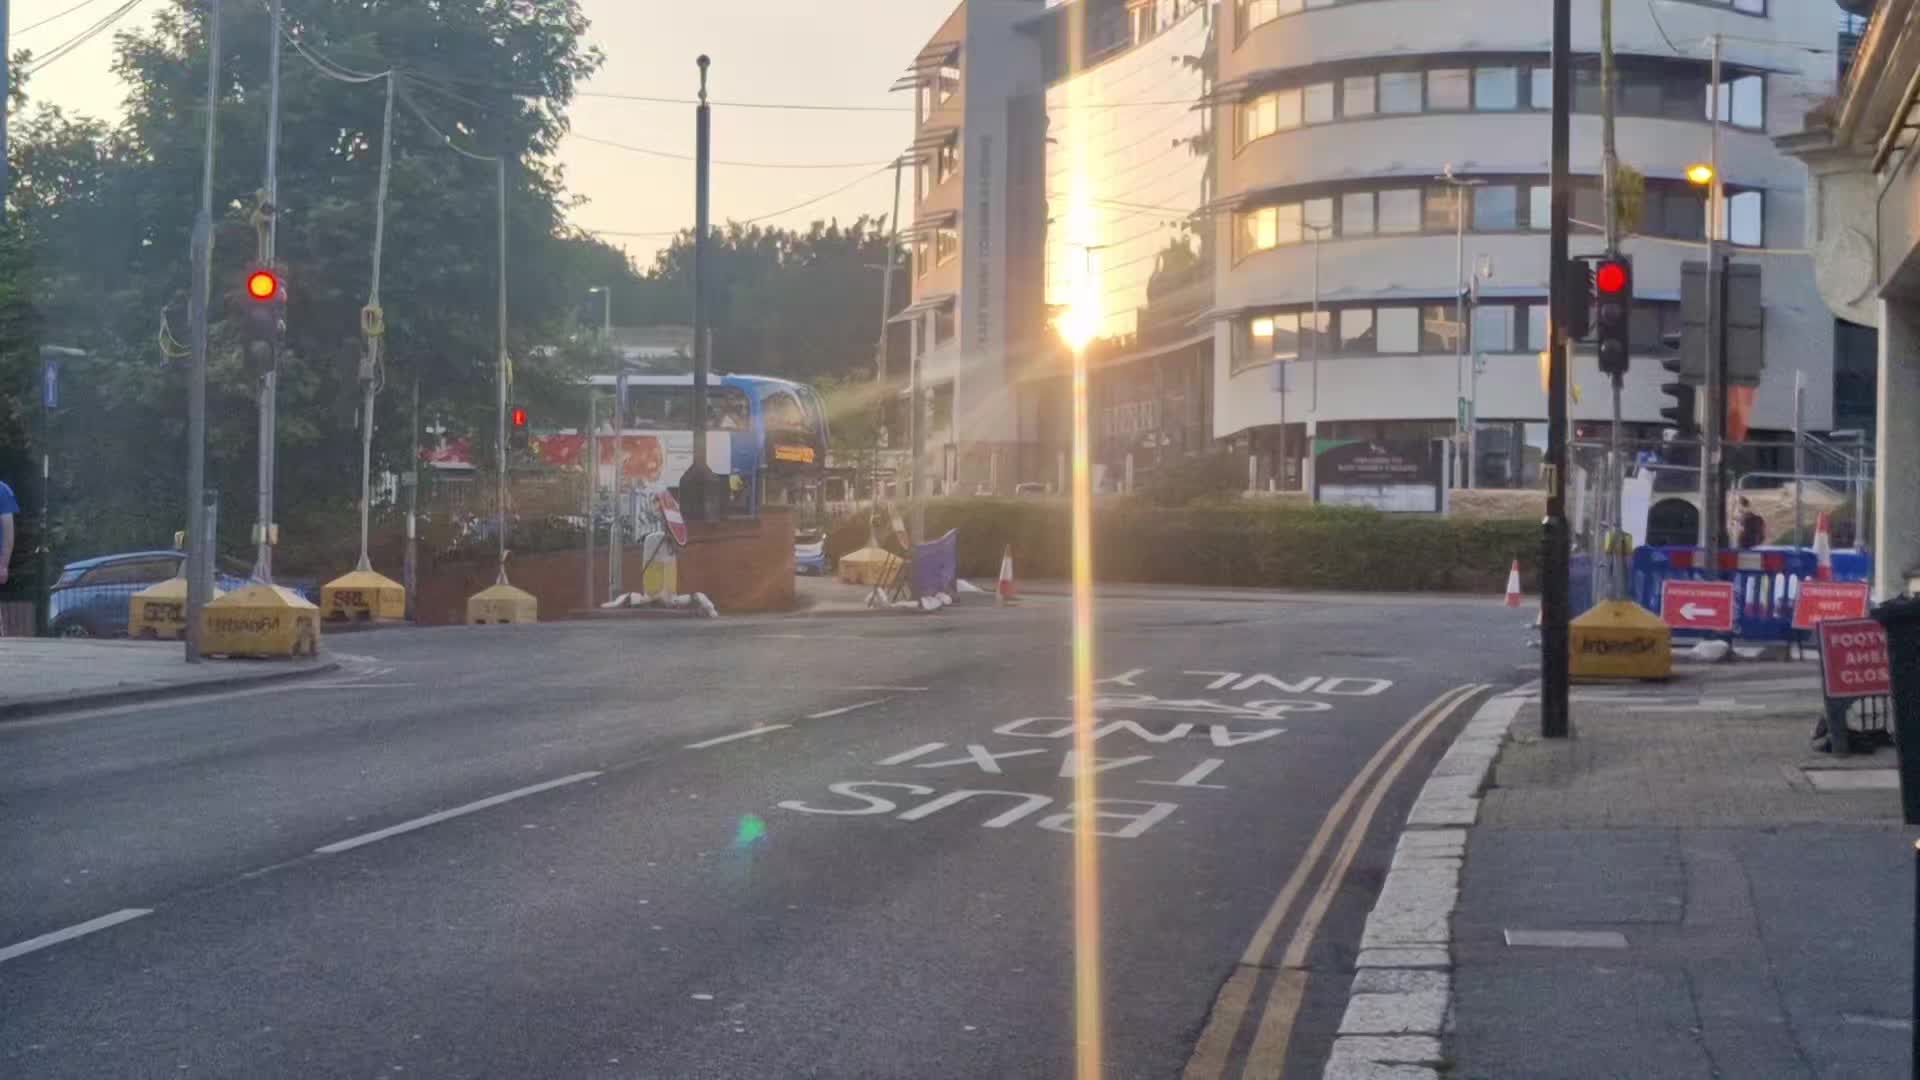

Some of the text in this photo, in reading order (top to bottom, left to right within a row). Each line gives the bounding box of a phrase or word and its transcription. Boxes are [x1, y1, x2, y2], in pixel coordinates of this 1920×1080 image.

[1093, 668, 1393, 695] ONLY
[1840, 668, 1890, 684] CLOS
[993, 717, 1289, 747] AND
[873, 743, 1226, 788] TAXI
[777, 781, 1179, 838] BUS
